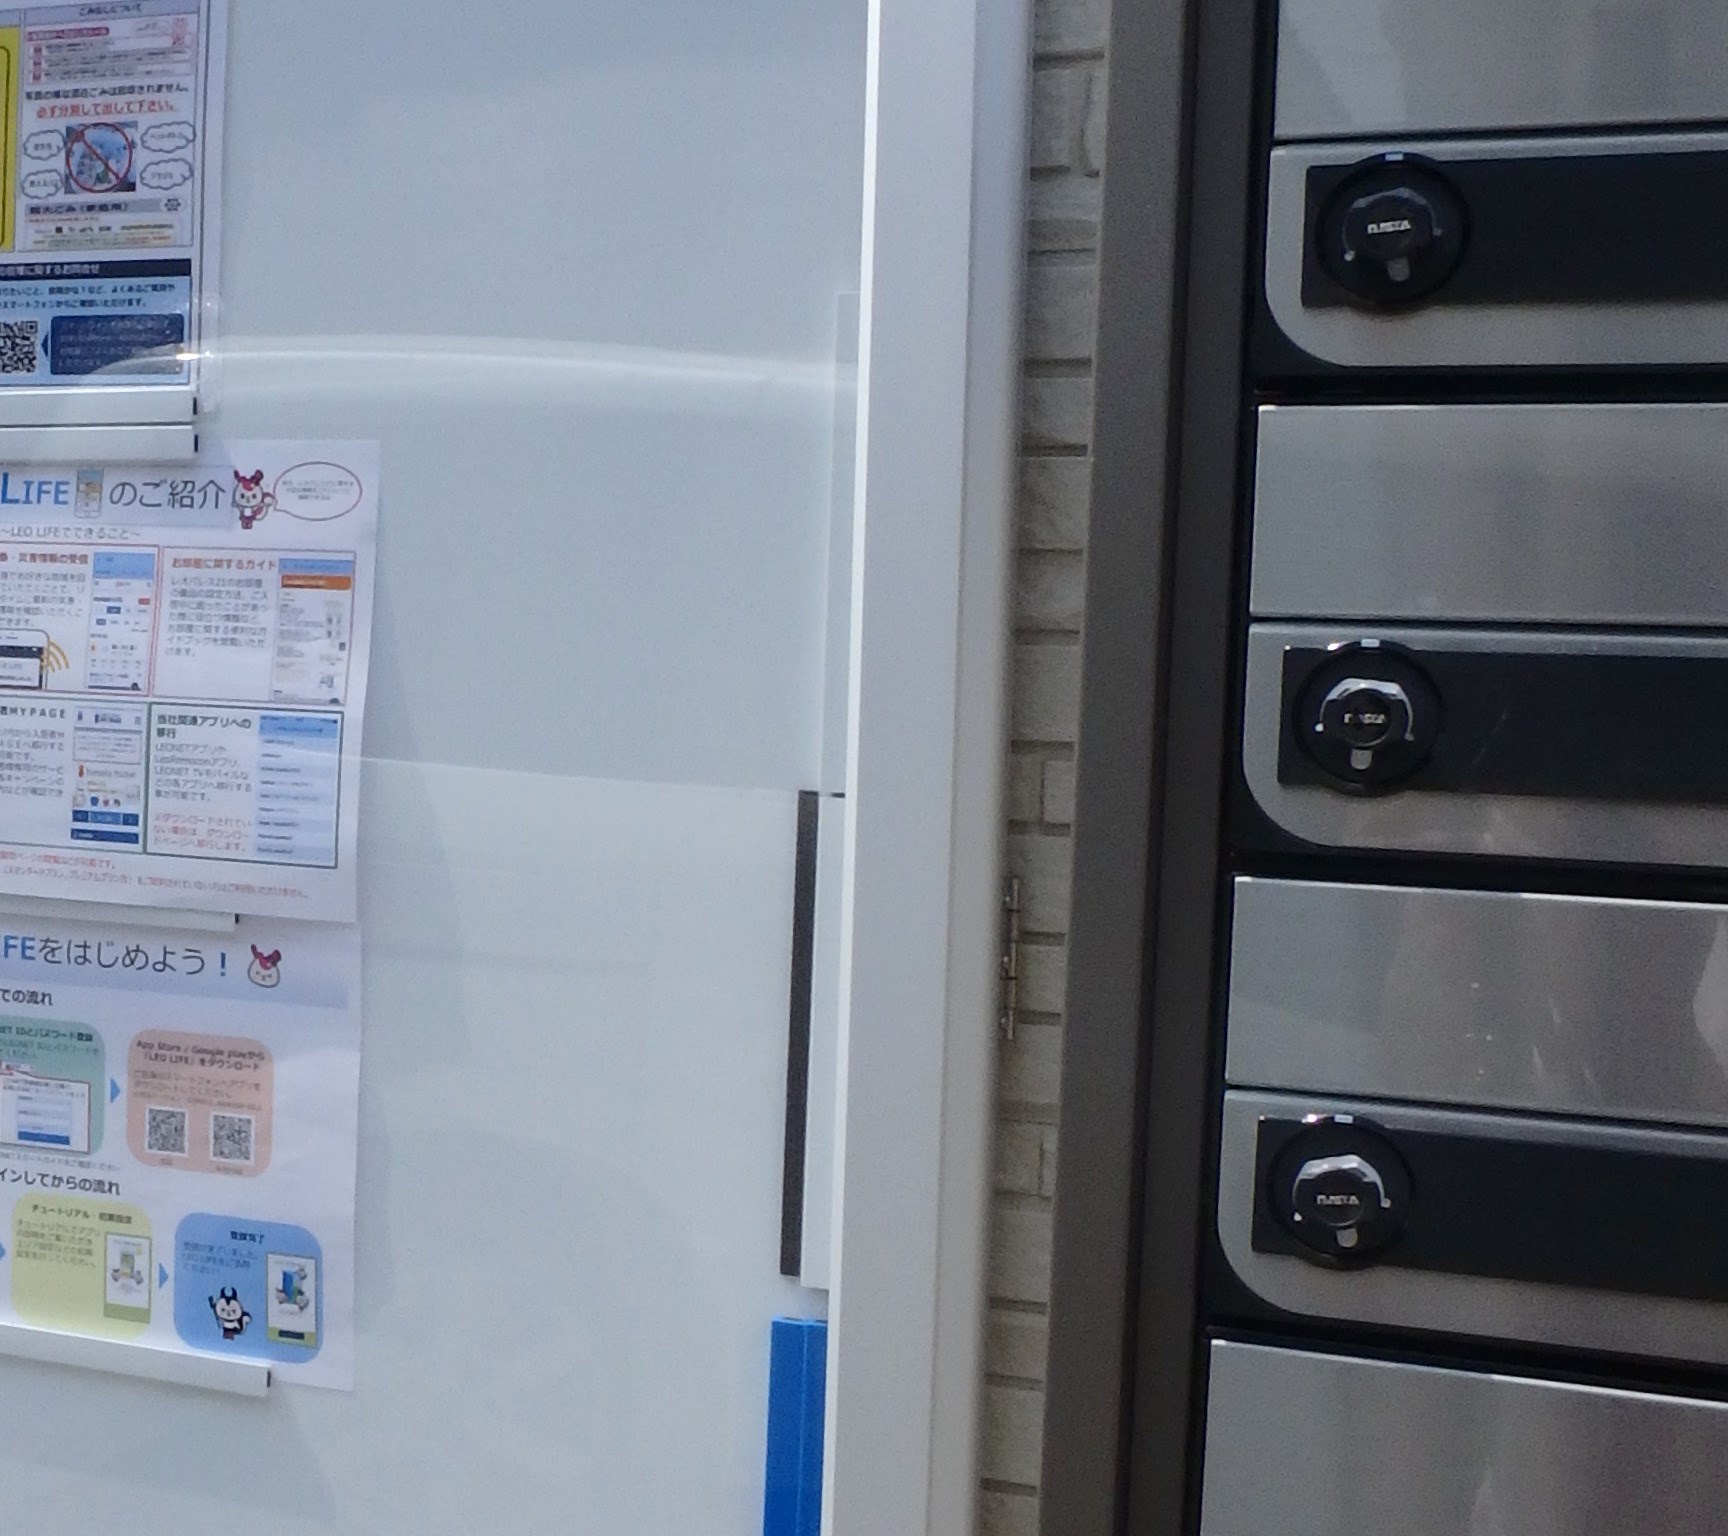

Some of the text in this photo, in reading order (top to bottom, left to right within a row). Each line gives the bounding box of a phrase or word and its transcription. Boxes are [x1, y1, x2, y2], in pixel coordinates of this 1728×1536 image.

[0, 472, 70, 505] LIFE
[109, 478, 225, 510] のご紹介
